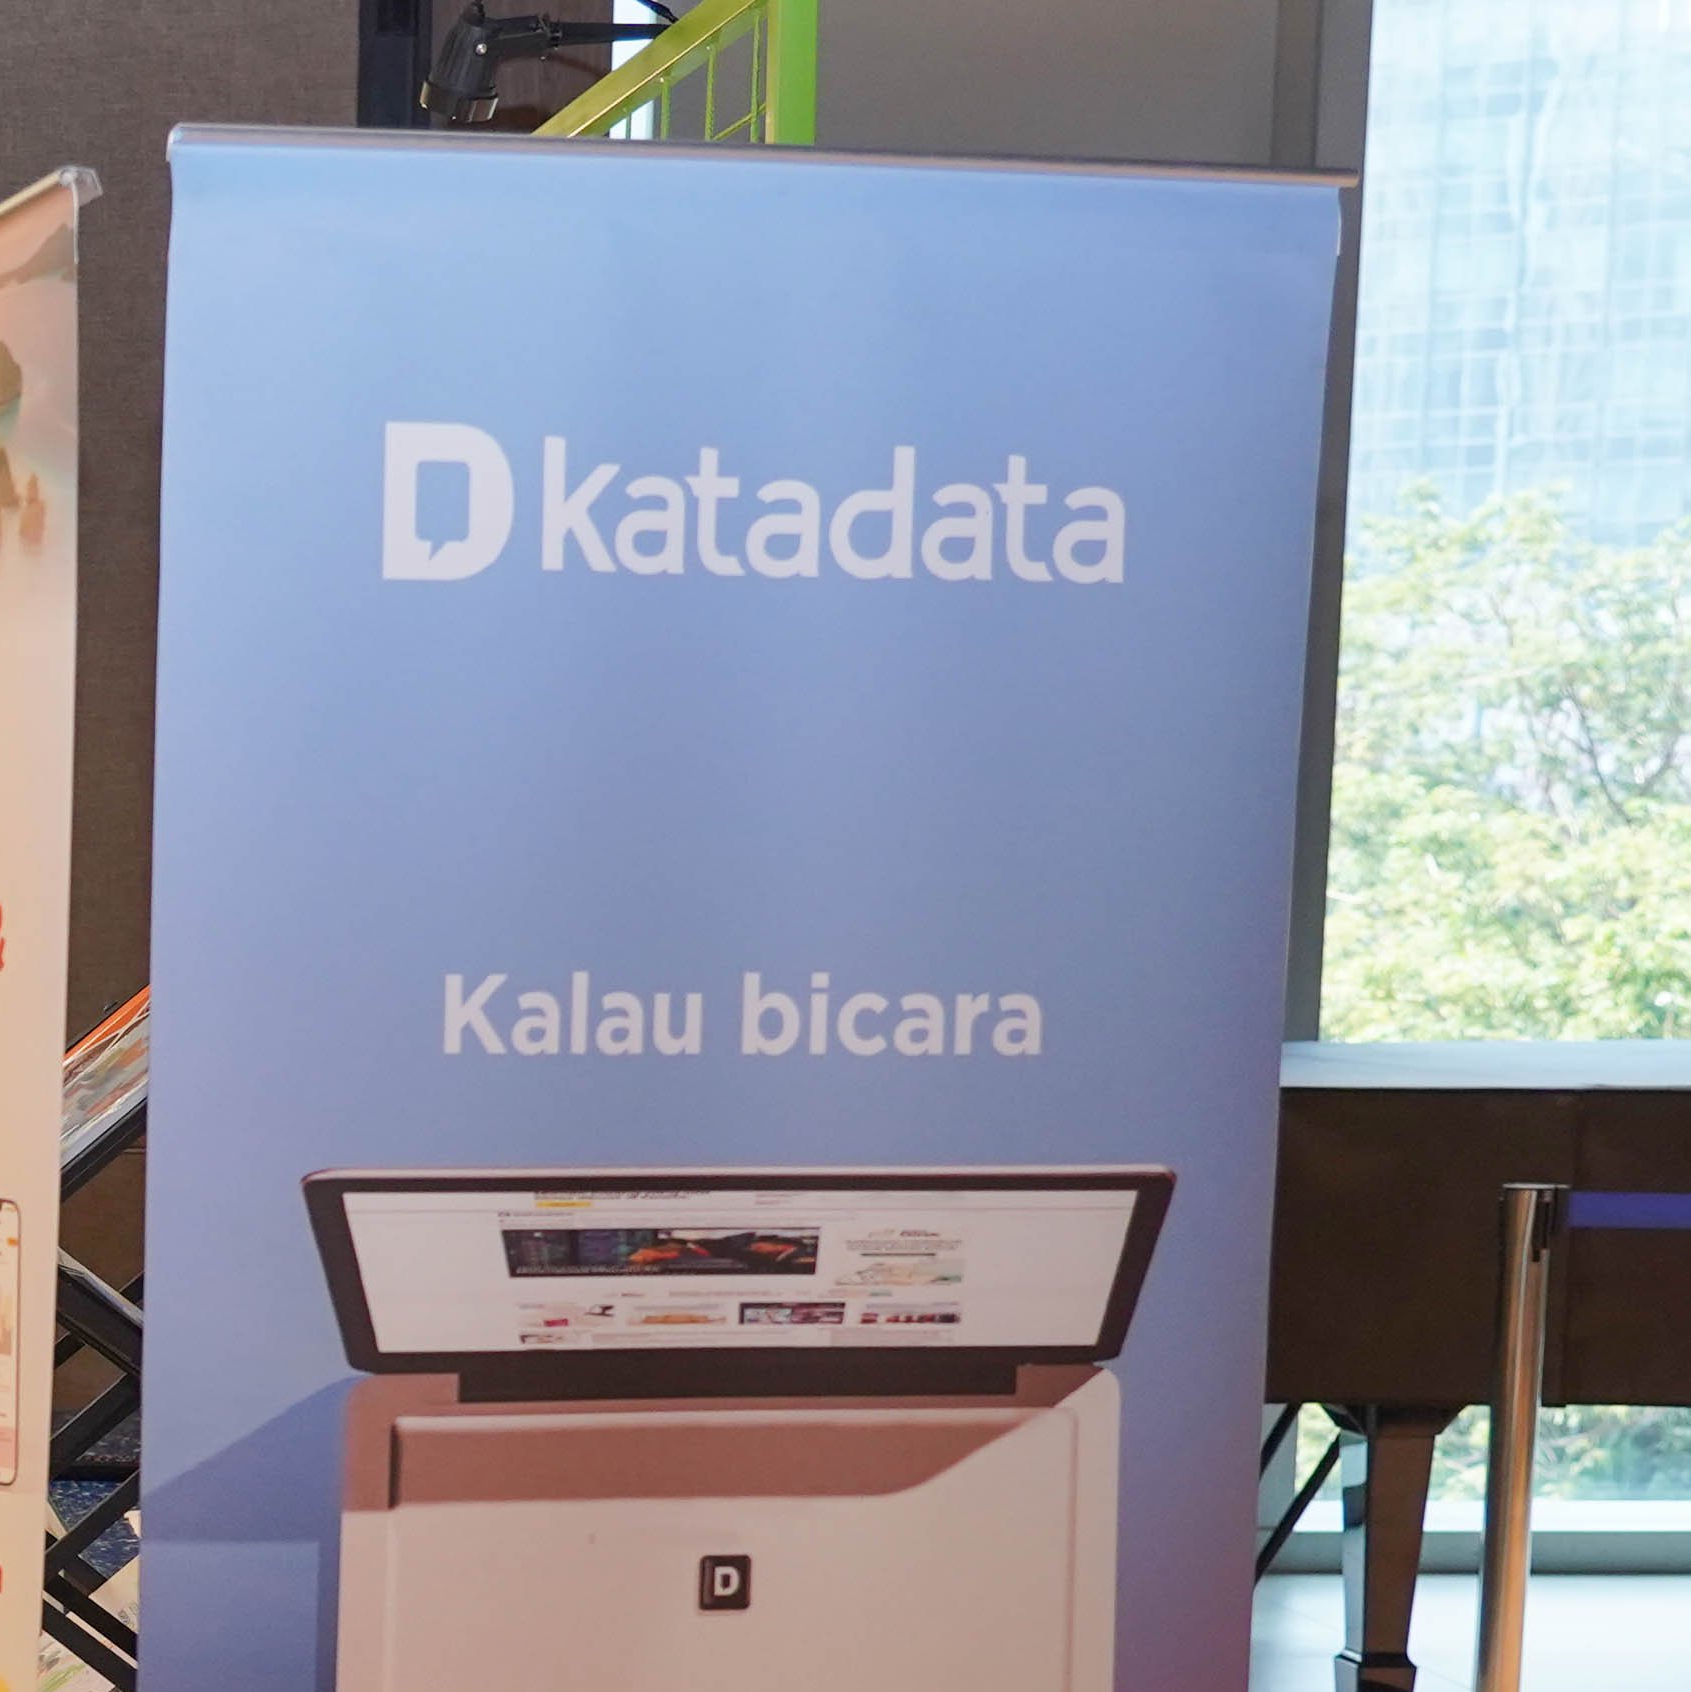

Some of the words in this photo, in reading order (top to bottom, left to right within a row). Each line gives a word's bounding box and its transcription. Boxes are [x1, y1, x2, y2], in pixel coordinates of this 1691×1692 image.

[541, 436, 1126, 583] katadata
[442, 971, 704, 1057] Kalau
[740, 971, 1044, 1058] bicara
